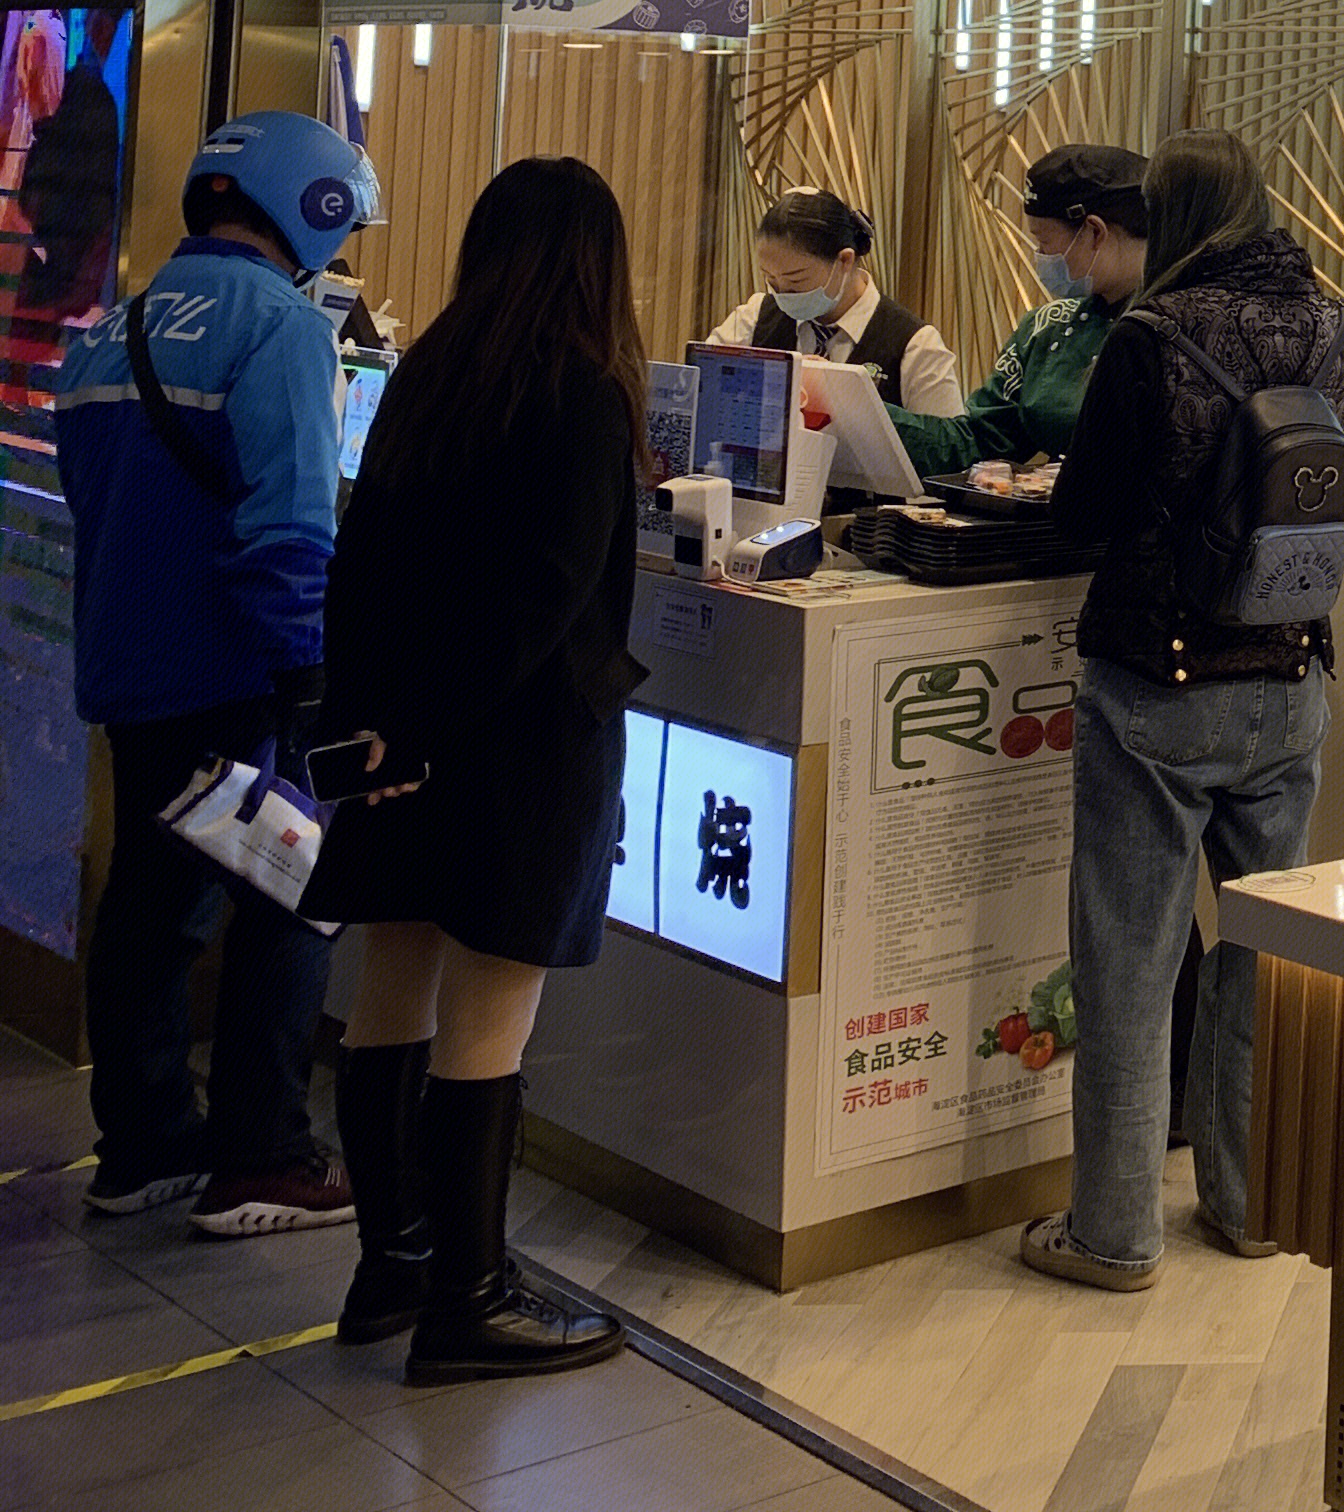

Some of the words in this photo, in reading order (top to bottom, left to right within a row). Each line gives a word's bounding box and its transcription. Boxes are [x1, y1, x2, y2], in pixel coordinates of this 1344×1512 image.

[1256, 554, 1298, 599] HONEST
[1302, 552, 1311, 565] &
[844, 1002, 931, 1041] 创建国家
[843, 1030, 949, 1078] 食品安全
[842, 1078, 930, 1114] 示范城市
